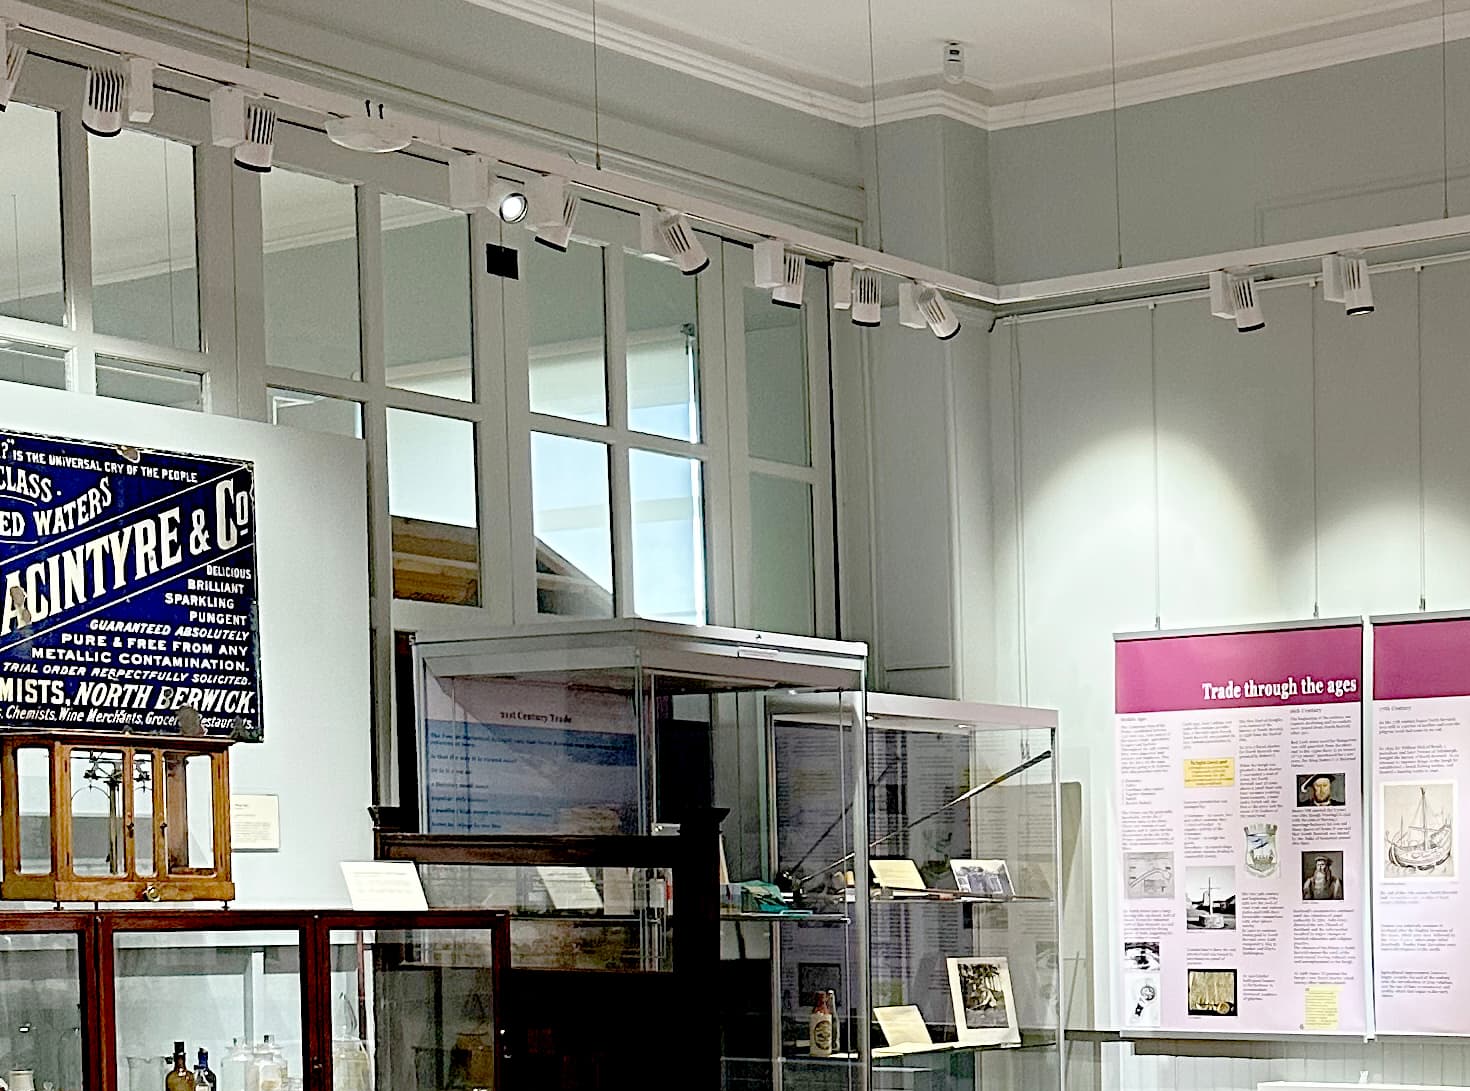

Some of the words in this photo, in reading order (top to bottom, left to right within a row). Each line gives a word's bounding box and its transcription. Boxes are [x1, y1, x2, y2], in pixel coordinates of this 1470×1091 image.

[13, 450, 23, 461] IS
[25, 452, 47, 465] THE
[49, 454, 102, 472] UNIVERSAL
[104, 462, 123, 474] CRY
[127, 464, 138, 476] OF
[141, 466, 159, 478] THE
[161, 468, 198, 484] PEOPLE
[33, 476, 112, 537] WATERS
[189, 508, 211, 555] &
[206, 564, 251, 580] DELICIOUS
[187, 579, 244, 594] BRILLIANT
[164, 592, 234, 610] SPARKLING
[89, 619, 170, 636] GUARANTEED
[174, 625, 250, 641] ABSOLUTELY
[189, 610, 247, 626] PUNGENT
[61, 633, 107, 647] PURE
[113, 637, 123, 648] &
[127, 638, 167, 651] FREE
[173, 641, 213, 655] FROM
[218, 645, 248, 657] ANY
[31, 648, 112, 663] METALLIC
[118, 652, 250, 672] CONTAMINATION.
[3, 662, 38, 674] TRIAL
[42, 664, 86, 676] ORDER
[191, 673, 251, 686] SOLICITED.
[74, 681, 153, 709] NORTH
[1202, 682, 1242, 700] Trade
[1243, 678, 1297, 700] through
[1301, 676, 1323, 693] the
[1327, 678, 1356, 697] ages
[59, 706, 85, 722] Wine
[517, 712, 548, 723] Century
[550, 714, 572, 724] Trade
